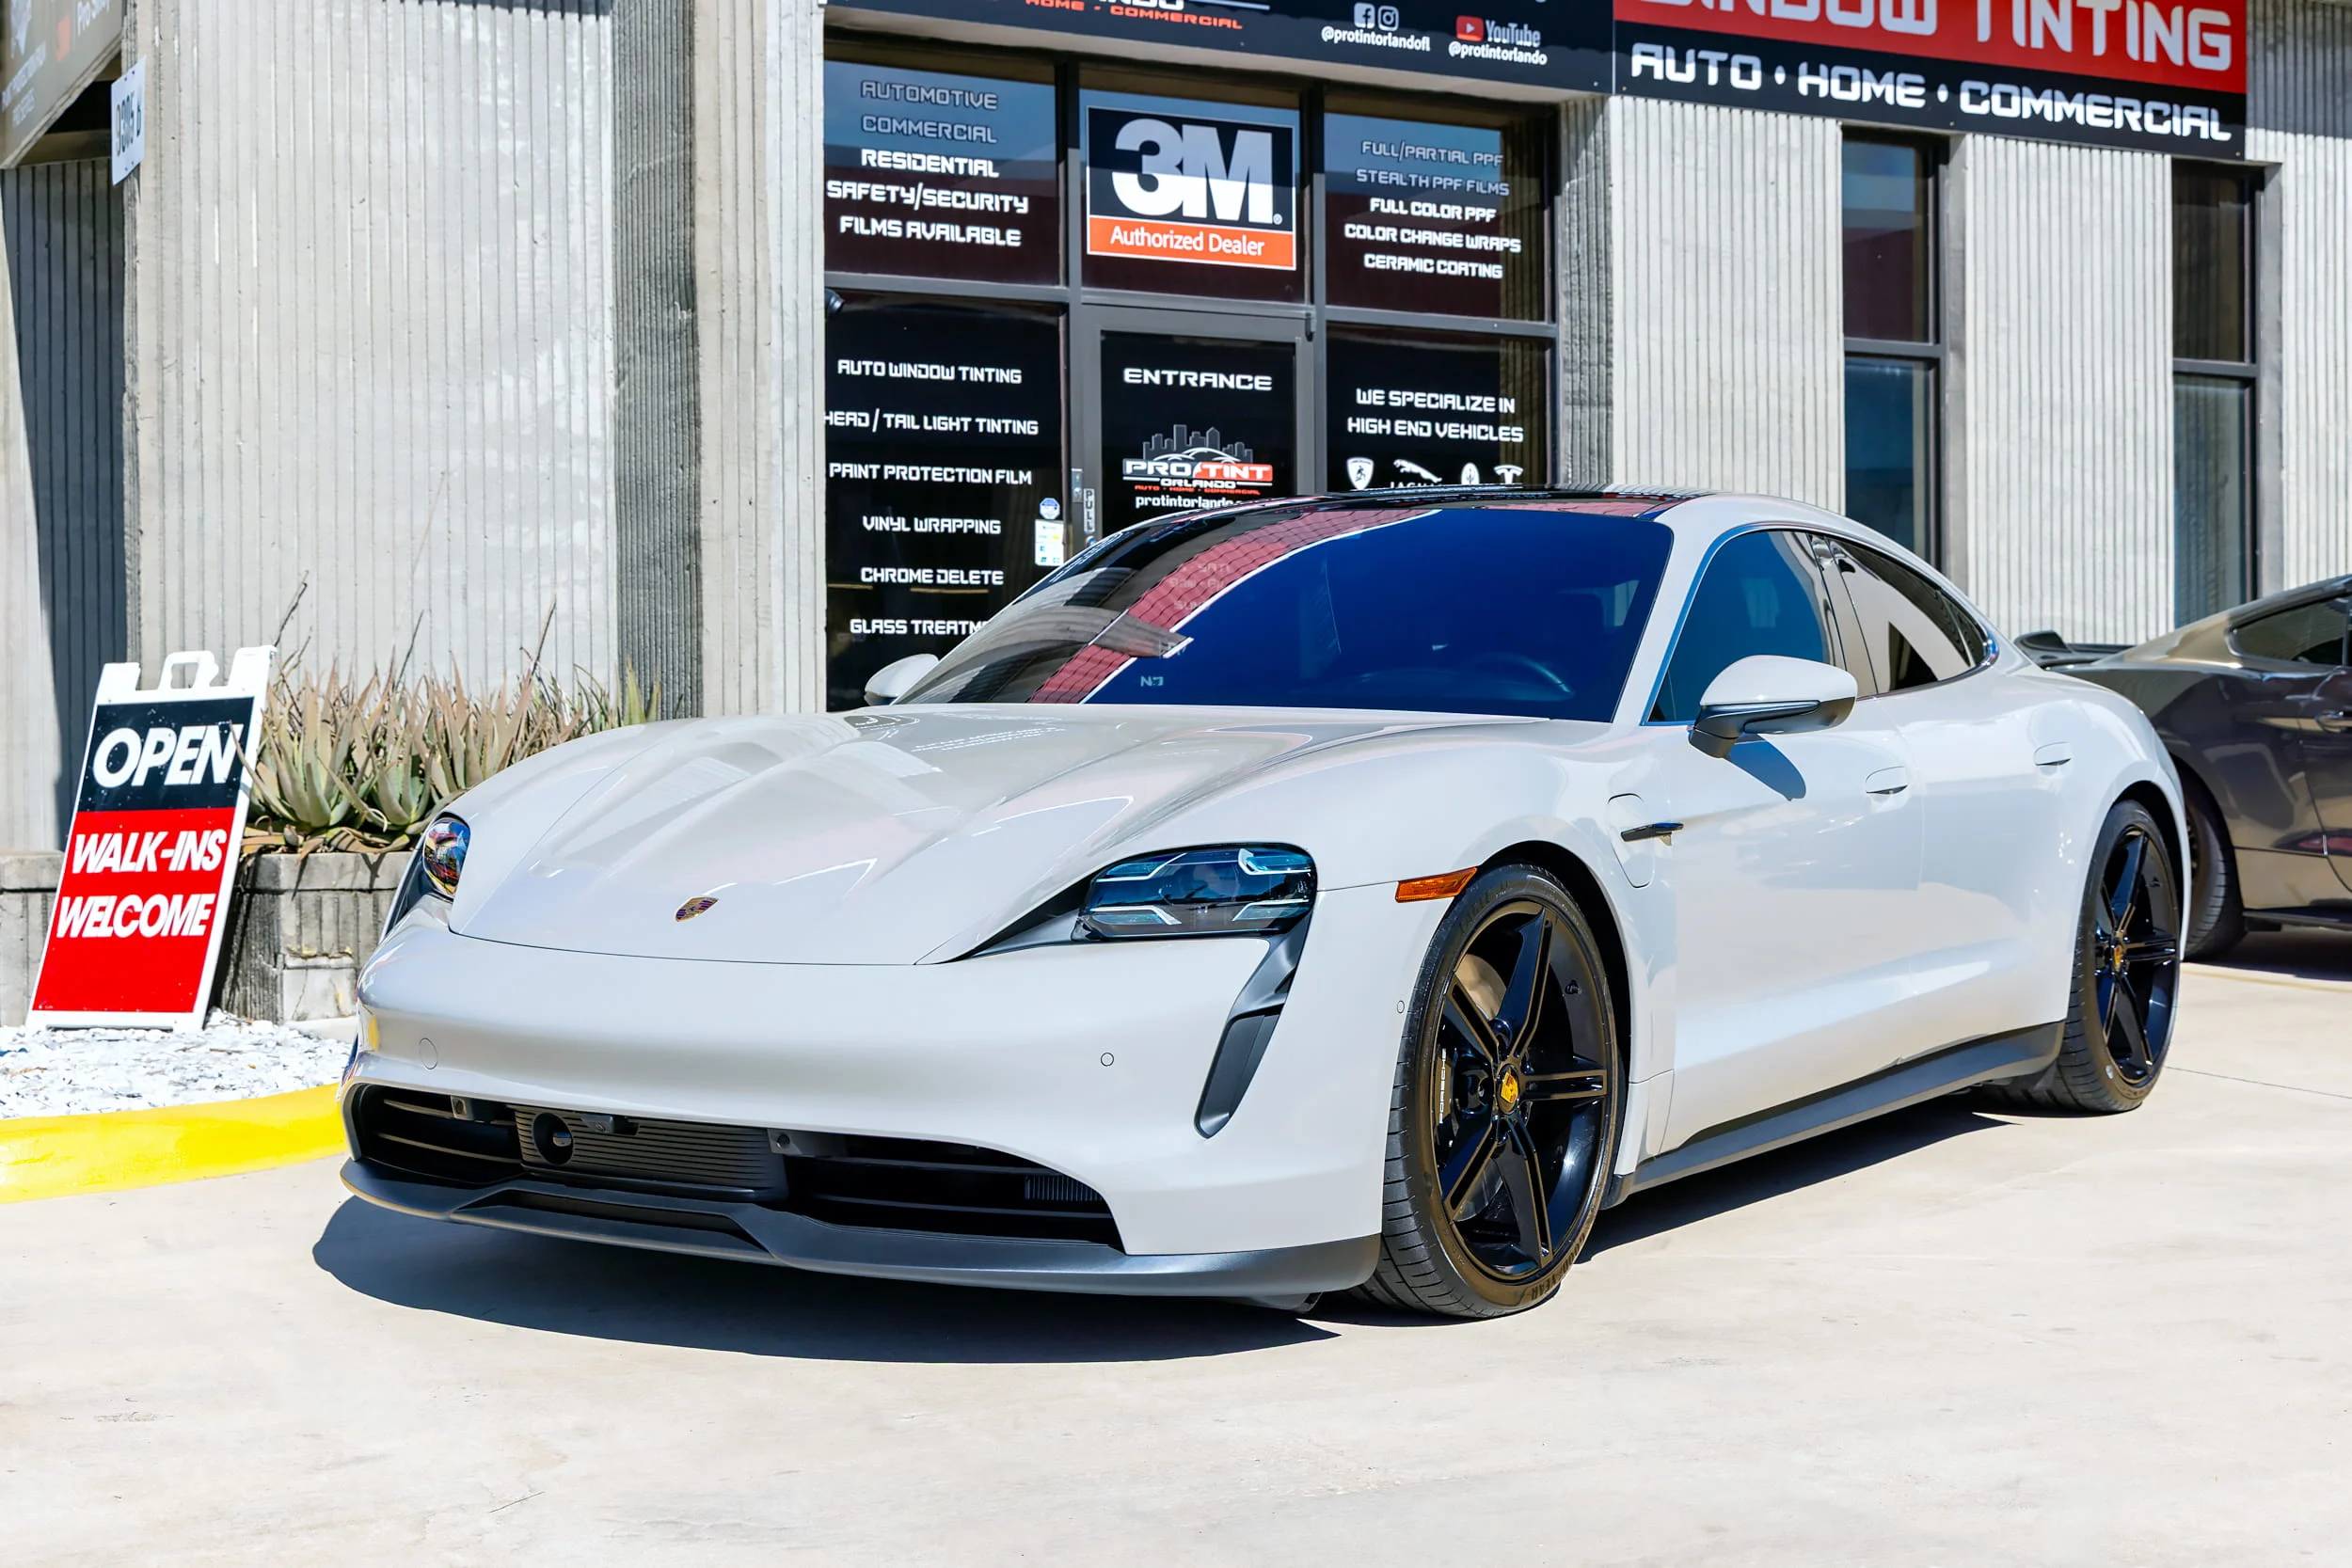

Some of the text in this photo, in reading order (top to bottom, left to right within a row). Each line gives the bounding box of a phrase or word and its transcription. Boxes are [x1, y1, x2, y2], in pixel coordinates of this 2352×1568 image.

[1110, 5, 1243, 30] COMMERCIAL
[1321, 26, 1430, 52] @protintorlandofl
[1486, 20, 1541, 47] YouTube
[1449, 41, 1548, 65] @protintorlando
[861, 81, 997, 110] AUTOMOTIVE
[1631, 42, 2232, 141] AUTO HOME COMMERCIAL
[862, 115, 997, 143] COMMERCIAL
[861, 149, 999, 178] RESIDENTIAL
[1361, 141, 1503, 167] FULL/PARTIAL PPF
[1112, 119, 1274, 225] 3M
[1357, 169, 1509, 196] STEALTH PPF FILMS
[827, 180, 1029, 214] SAFETY/SECURITY
[1370, 198, 1496, 222] FULL COLOR PPF
[840, 215, 1022, 246] FILMS AVAILABLE
[1110, 226, 1264, 256] Authorized Dealer
[1344, 224, 1521, 253] COLOR CHANGE WRAPS
[1364, 253, 1502, 278] CERAMIC COATING
[837, 359, 1022, 384] AUTO WINDOW TINTING
[1124, 368, 1272, 390] ENTRANCE
[1356, 388, 1515, 414] WE SPECIALIZE IN
[824, 411, 869, 426] HEAD
[882, 413, 920, 430] TAIL
[923, 416, 971, 432] LIGHT
[975, 418, 1039, 436] TINTING
[1347, 417, 1524, 442] HIGH END VEHICLES
[830, 463, 1031, 485] PAINT PROTECTION FILM
[1160, 478, 1237, 489] ORLANDO
[1201, 465, 1270, 480] TINT
[863, 515, 1001, 534] VINYL WRAPPING
[861, 567, 1004, 585] CHROME DELETE
[850, 618, 988, 636] GLASS TREATM
[93, 723, 244, 788] OPEN
[72, 829, 227, 874] WALK-INS
[56, 894, 215, 939] WELCOME
